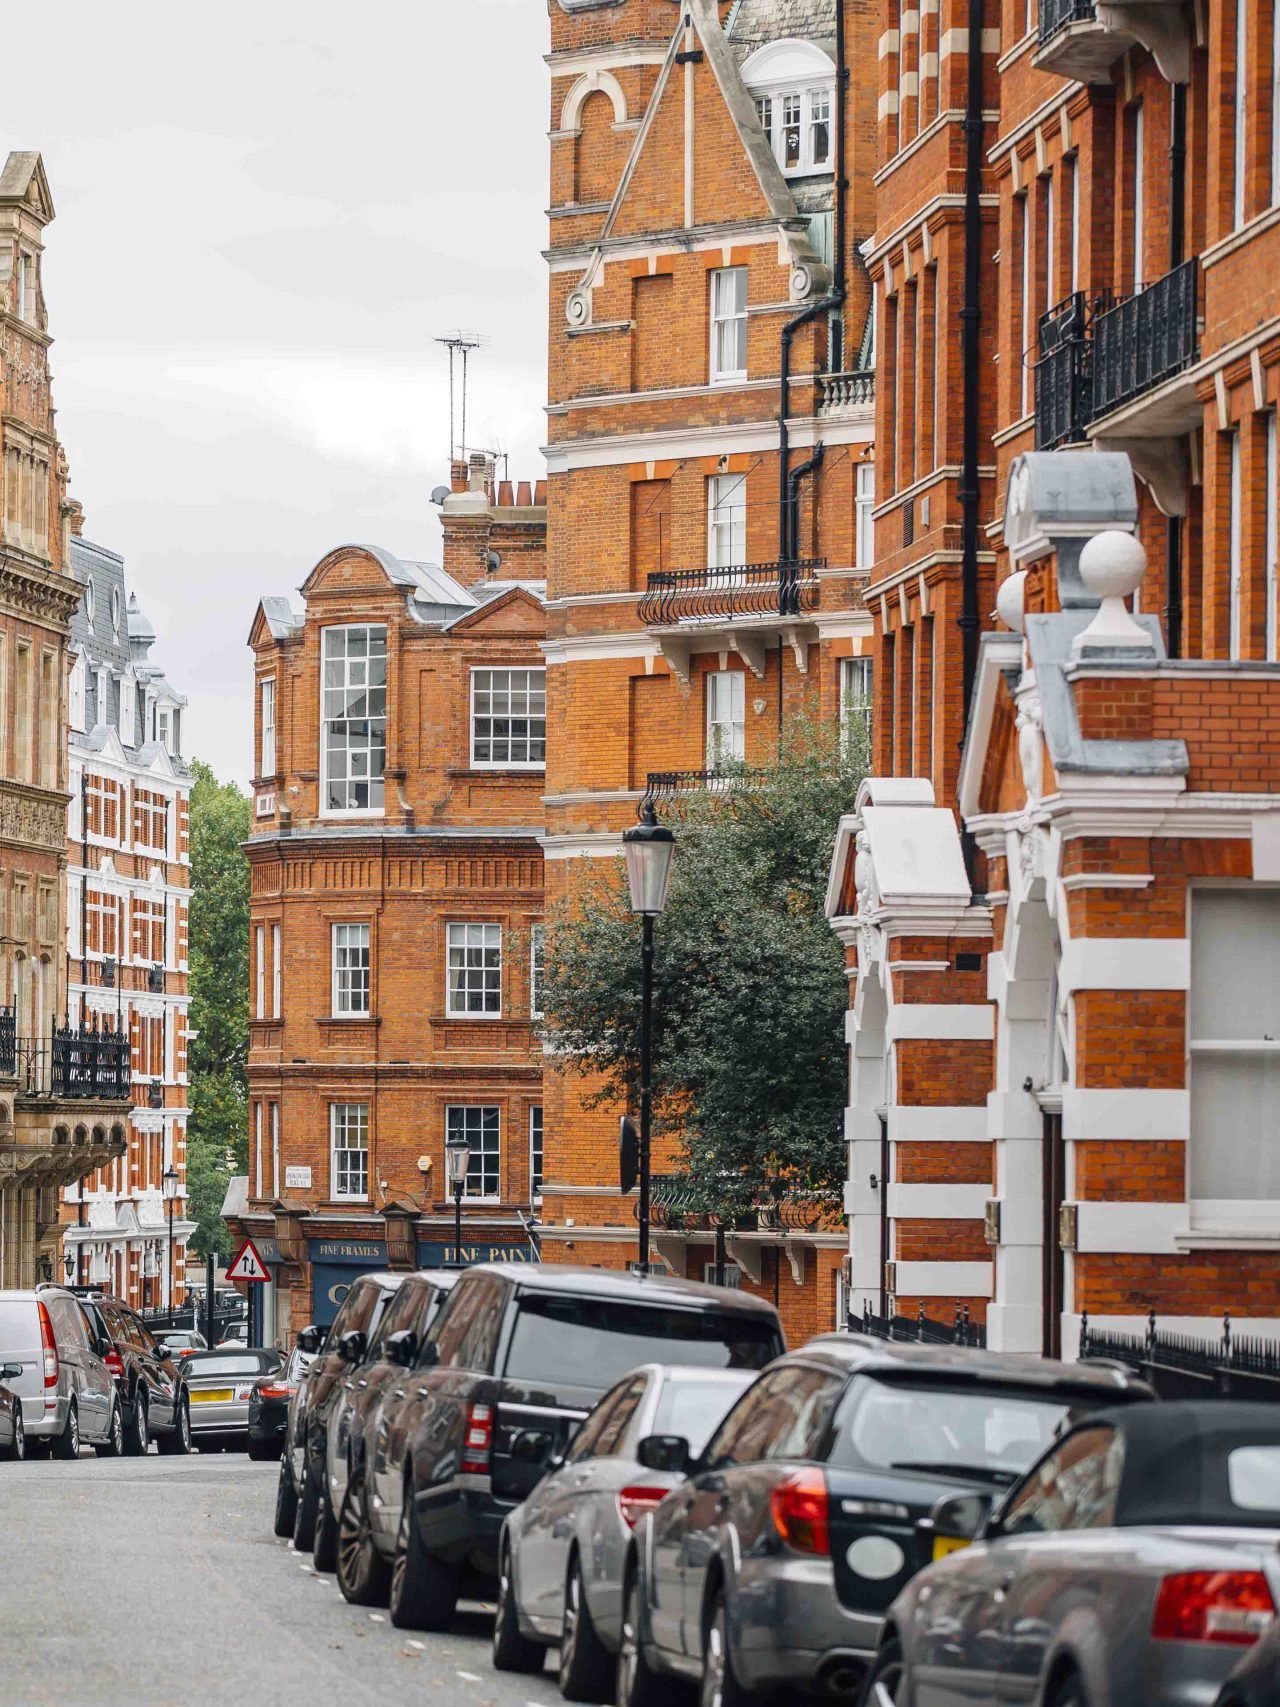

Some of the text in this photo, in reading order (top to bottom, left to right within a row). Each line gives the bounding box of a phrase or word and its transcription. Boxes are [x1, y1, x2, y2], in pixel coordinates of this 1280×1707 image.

[320, 1245, 380, 1257] FINE FRAMES
[444, 1247, 529, 1264] FINE PAIN
